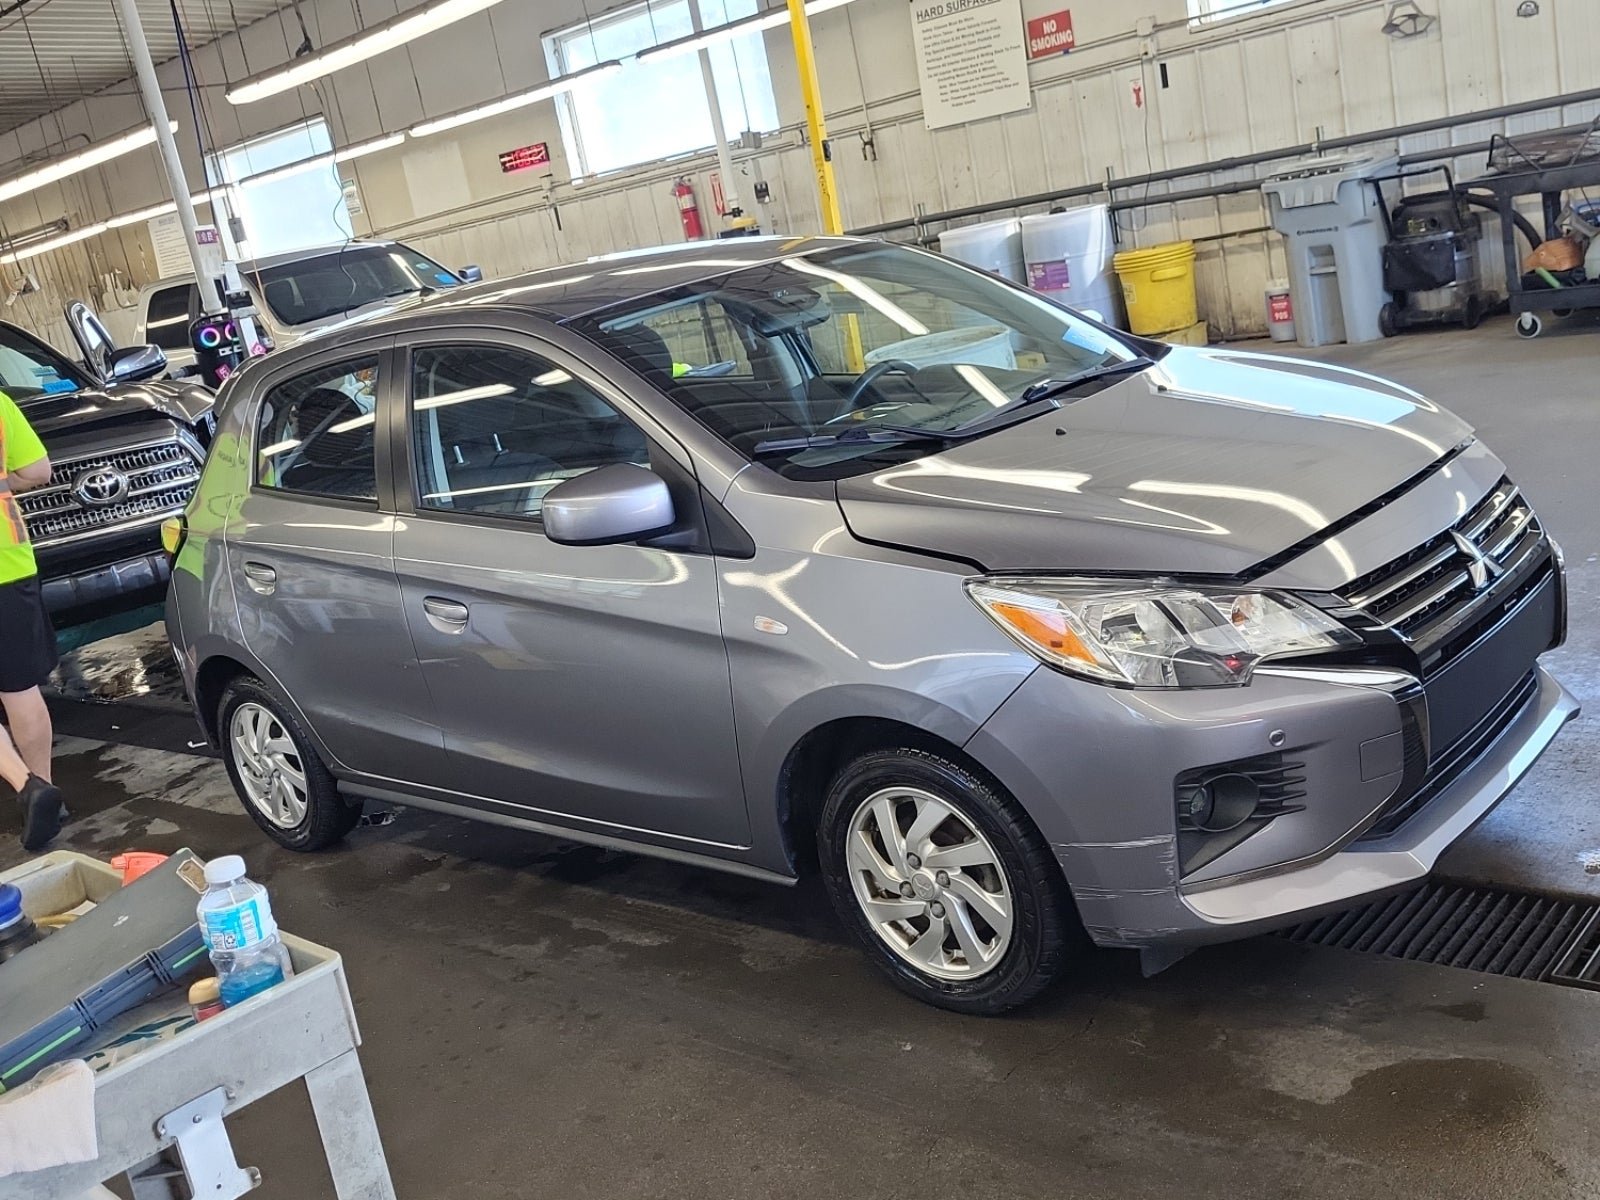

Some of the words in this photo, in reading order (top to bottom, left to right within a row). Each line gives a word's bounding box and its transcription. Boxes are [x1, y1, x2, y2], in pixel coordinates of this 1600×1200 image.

[916, 4, 944, 21] HARD
[1042, 19, 1057, 35] NO
[1031, 29, 1073, 52] SMOKING
